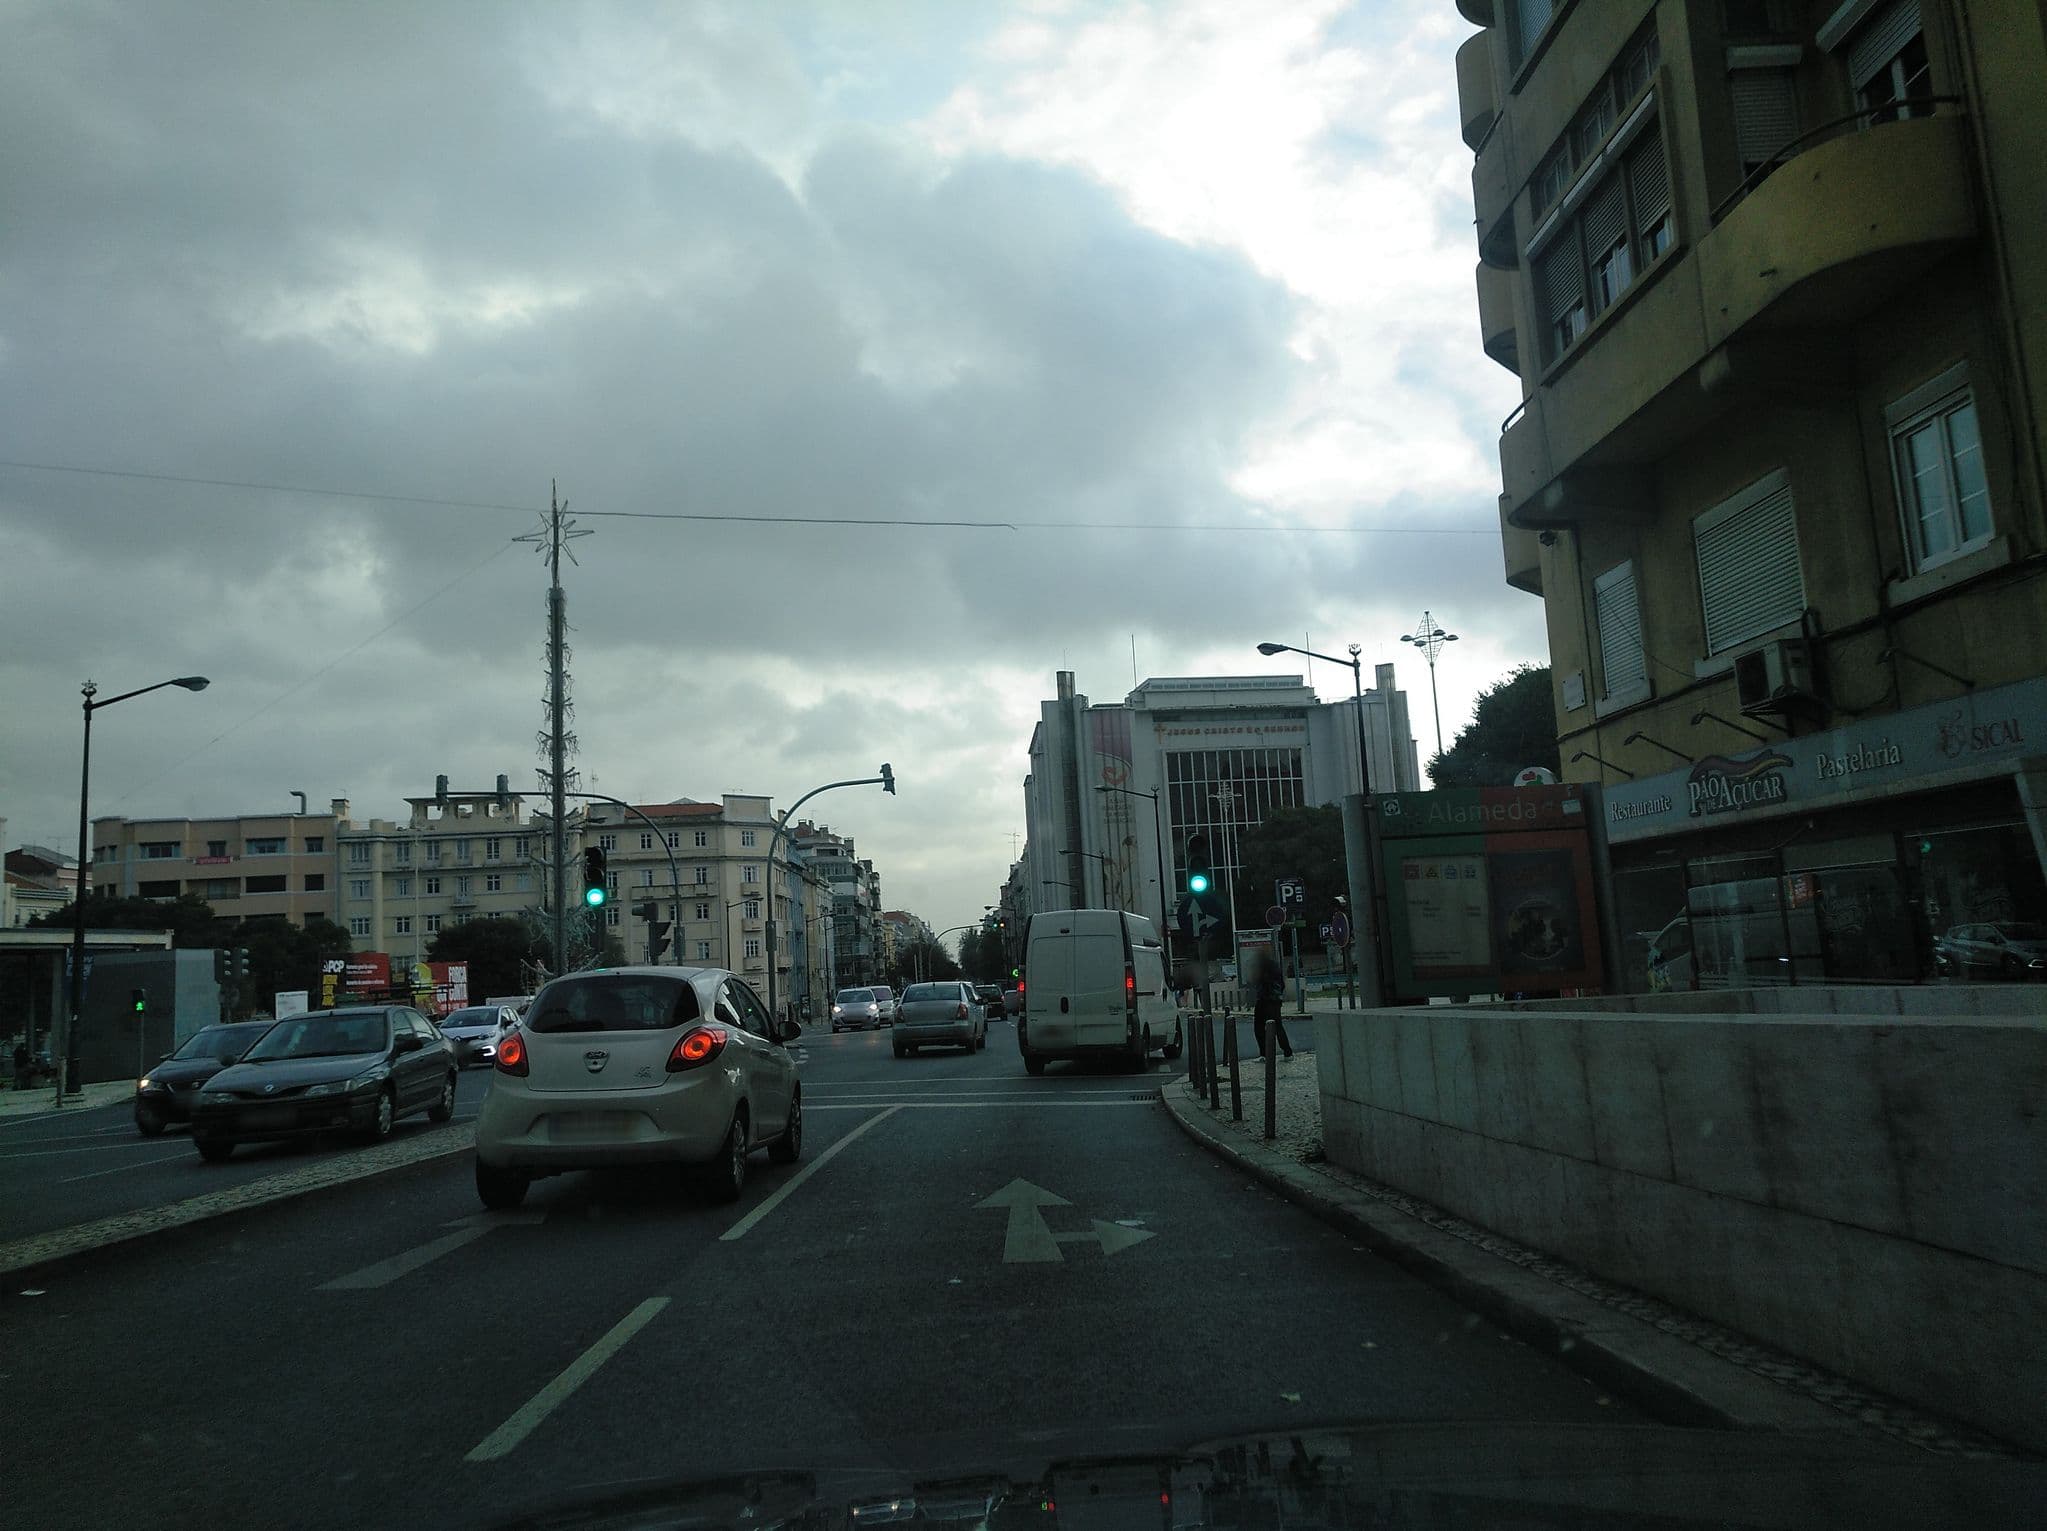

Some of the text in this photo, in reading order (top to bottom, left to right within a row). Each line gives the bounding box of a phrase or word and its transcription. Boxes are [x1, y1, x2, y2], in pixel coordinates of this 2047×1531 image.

[1973, 719, 2024, 751] SICAL
[1816, 738, 1901, 780] Pastelaria
[1718, 776, 1784, 810] AÇÚCAR
[1430, 797, 1536, 823] Alameda
[1611, 795, 1672, 822] Restaurante
[1282, 886, 1294, 902] P
[328, 960, 344, 972] PCP
